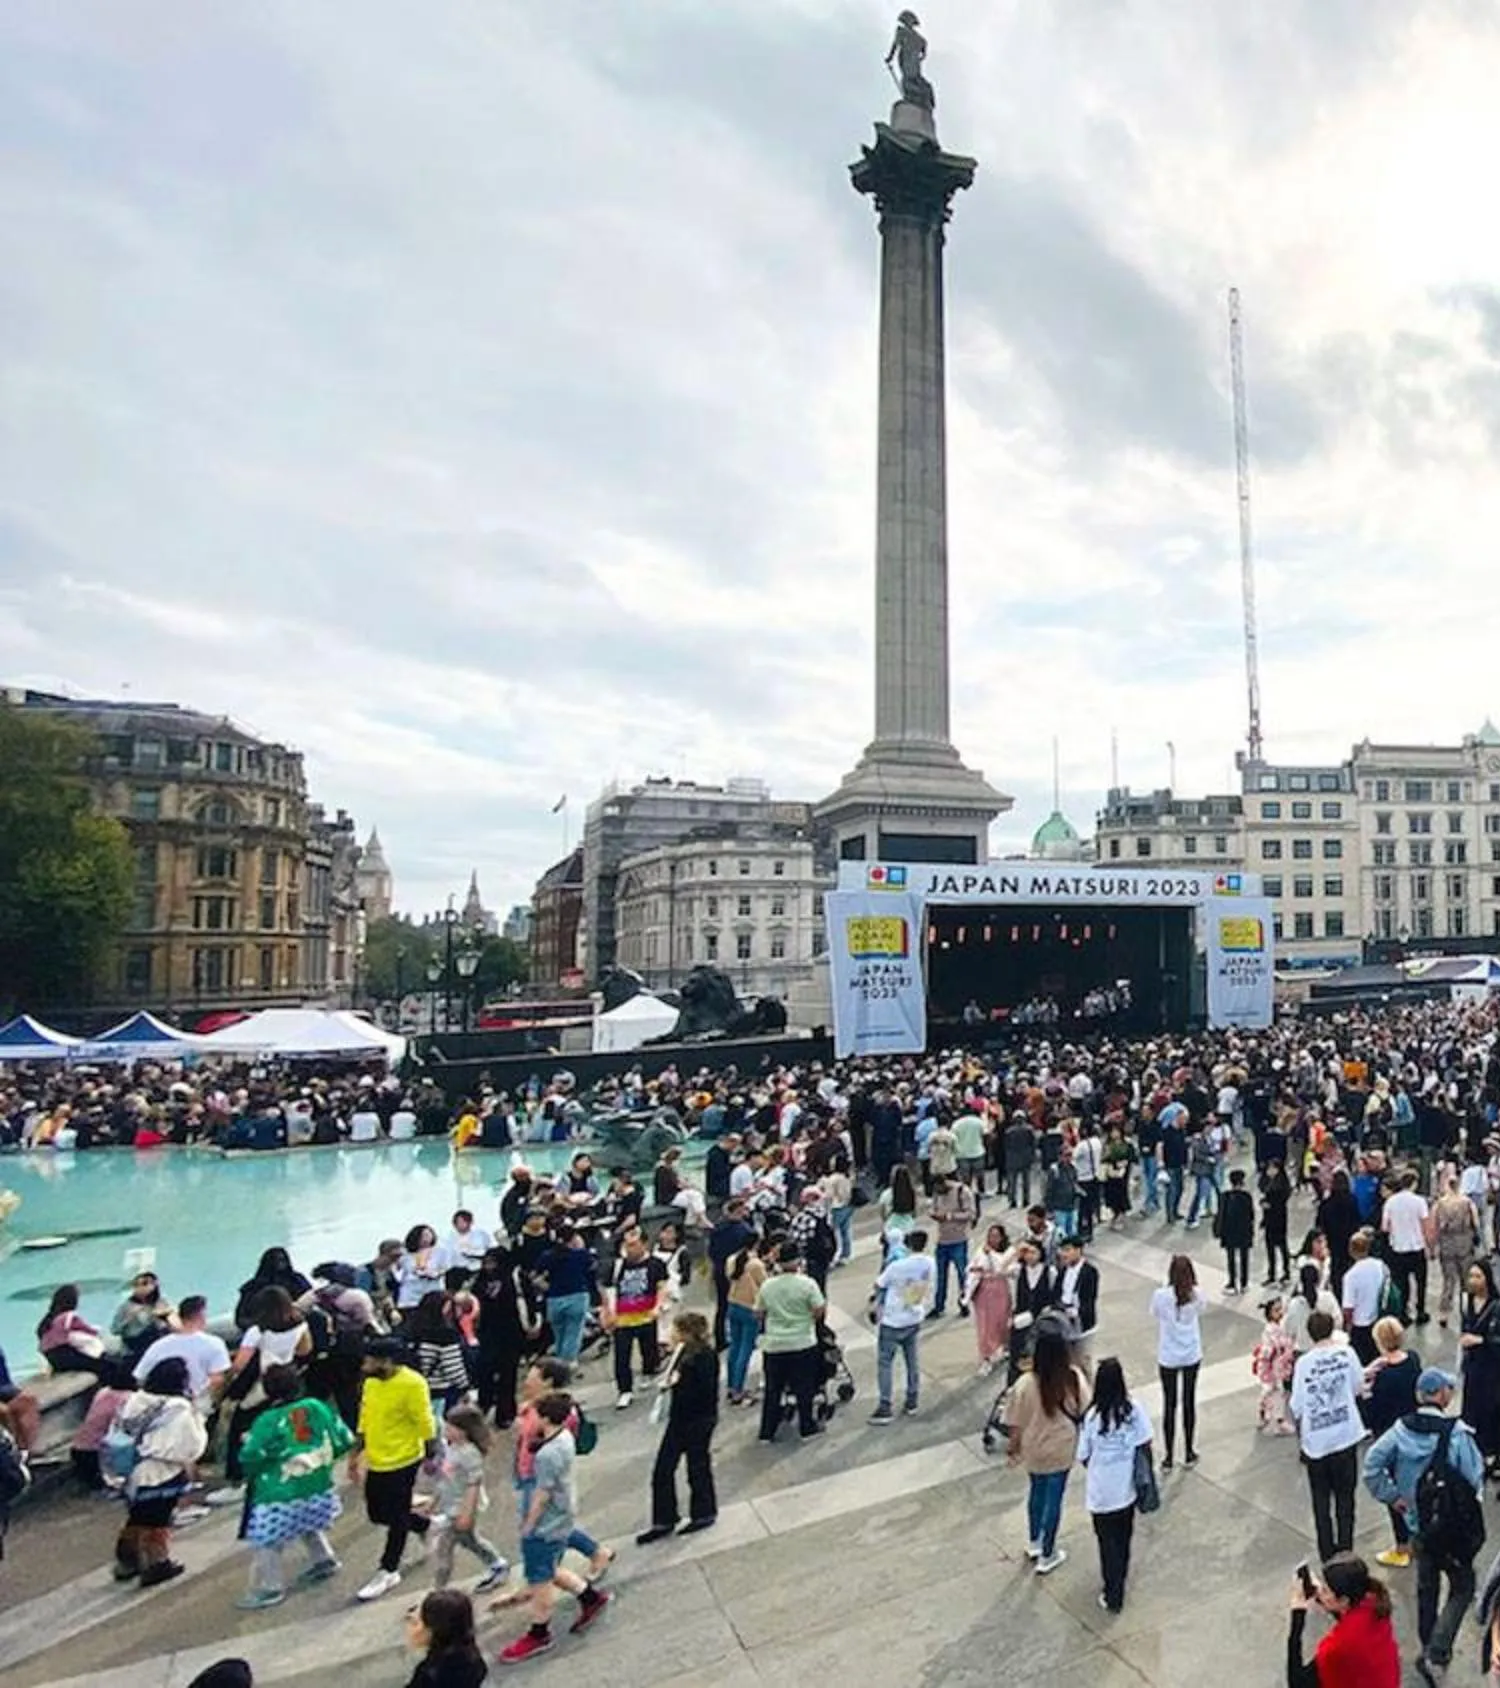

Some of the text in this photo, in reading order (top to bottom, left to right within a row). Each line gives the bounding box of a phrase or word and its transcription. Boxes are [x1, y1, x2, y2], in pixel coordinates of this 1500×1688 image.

[927, 874, 1201, 897] JAPAN MATSURI 2023
[1226, 956, 1261, 967] JAPAN
[858, 964, 903, 975] JAPAN
[850, 976, 913, 989] MATSURI
[863, 988, 898, 1000] 2023
